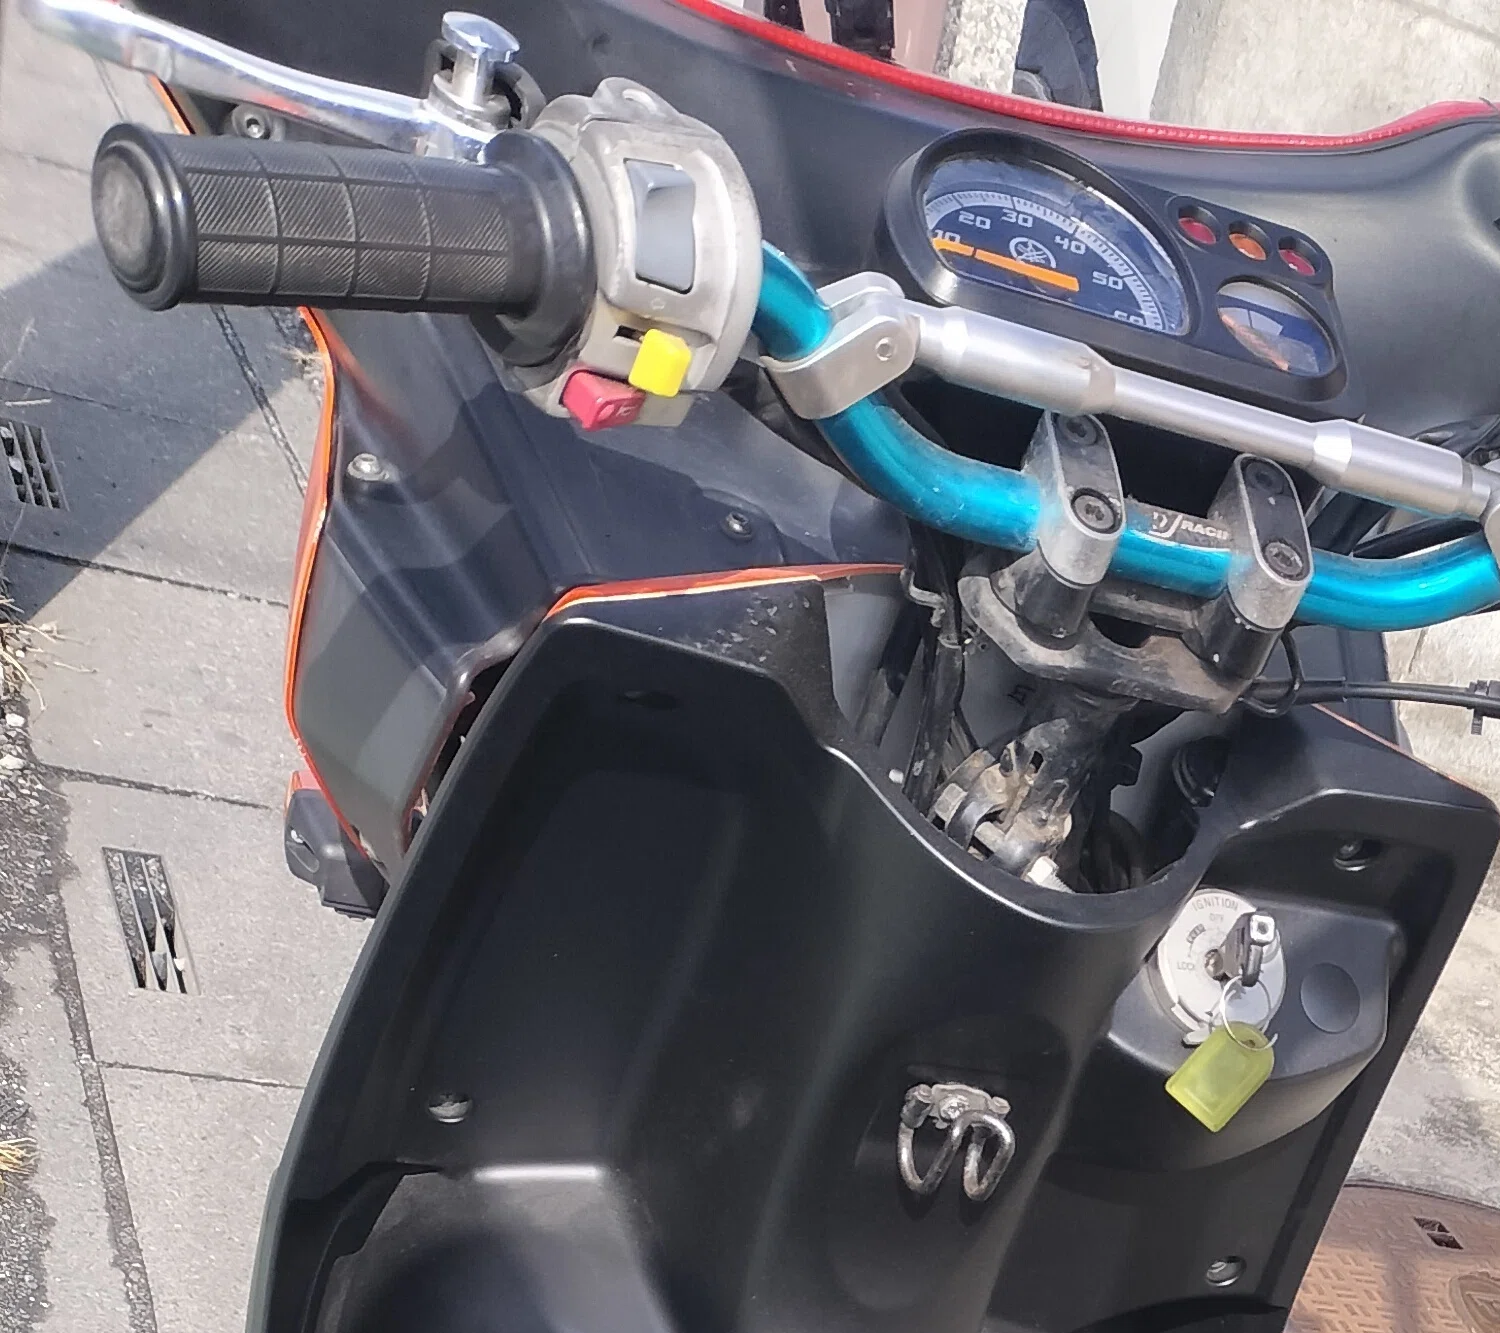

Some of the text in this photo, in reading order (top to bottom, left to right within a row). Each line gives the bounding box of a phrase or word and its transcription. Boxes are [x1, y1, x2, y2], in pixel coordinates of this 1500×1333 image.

[958, 211, 992, 229] 20
[1001, 209, 1033, 228] 30
[1054, 234, 1087, 255] 40
[1092, 270, 1124, 291] 50
[1191, 897, 1239, 912] IGNITION
